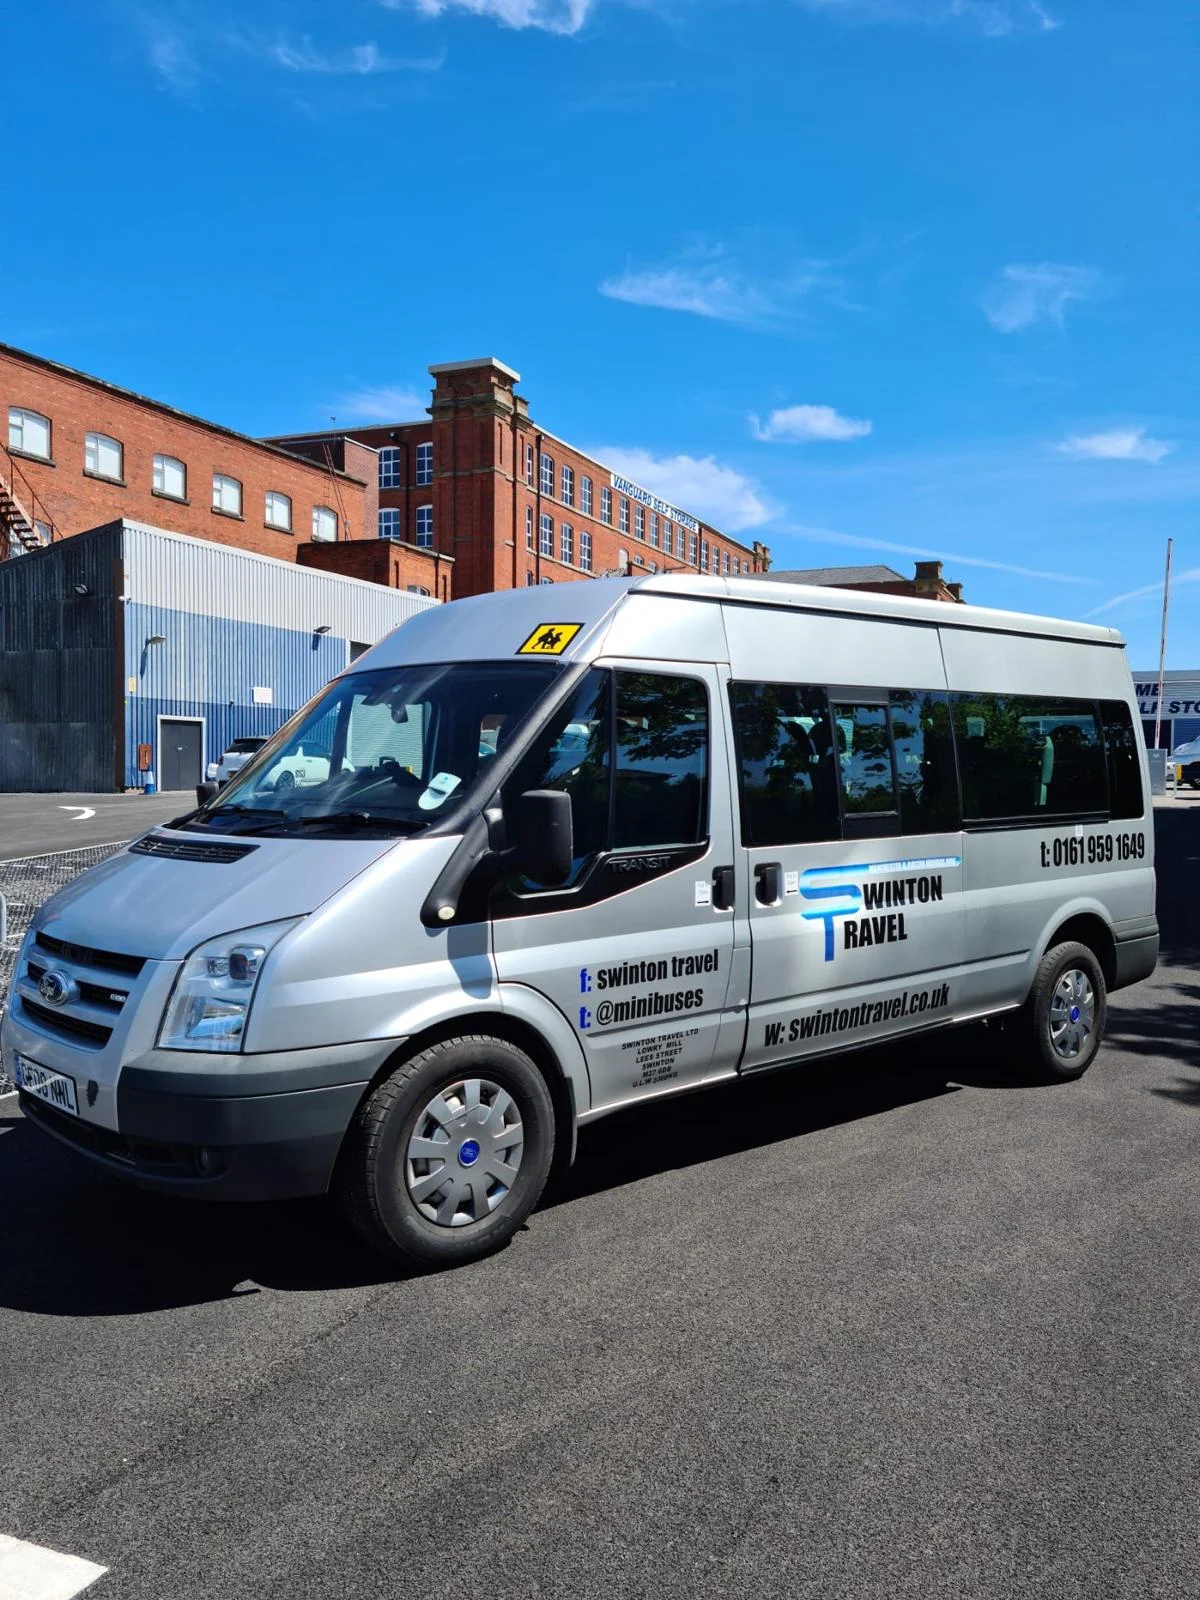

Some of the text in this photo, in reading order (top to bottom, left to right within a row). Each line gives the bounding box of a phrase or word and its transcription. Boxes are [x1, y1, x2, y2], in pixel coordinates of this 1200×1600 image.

[613, 474, 697, 531] VANGUARD SELF STORAGE
[609, 855, 672, 873] TRANSIT
[1040, 832, 1145, 868] t: 0161 959 1649
[579, 949, 719, 993] f: swinton travel
[579, 988, 704, 1029] t: @minibuses
[788, 983, 950, 1042] swintontravel.co.uk
[622, 1028, 699, 1050] SWINTON TRAVEL LTD
[637, 1039, 682, 1055] LOWRY MILL
[635, 1047, 683, 1064] LEES STREET
[642, 1057, 675, 1070] SWINTON
